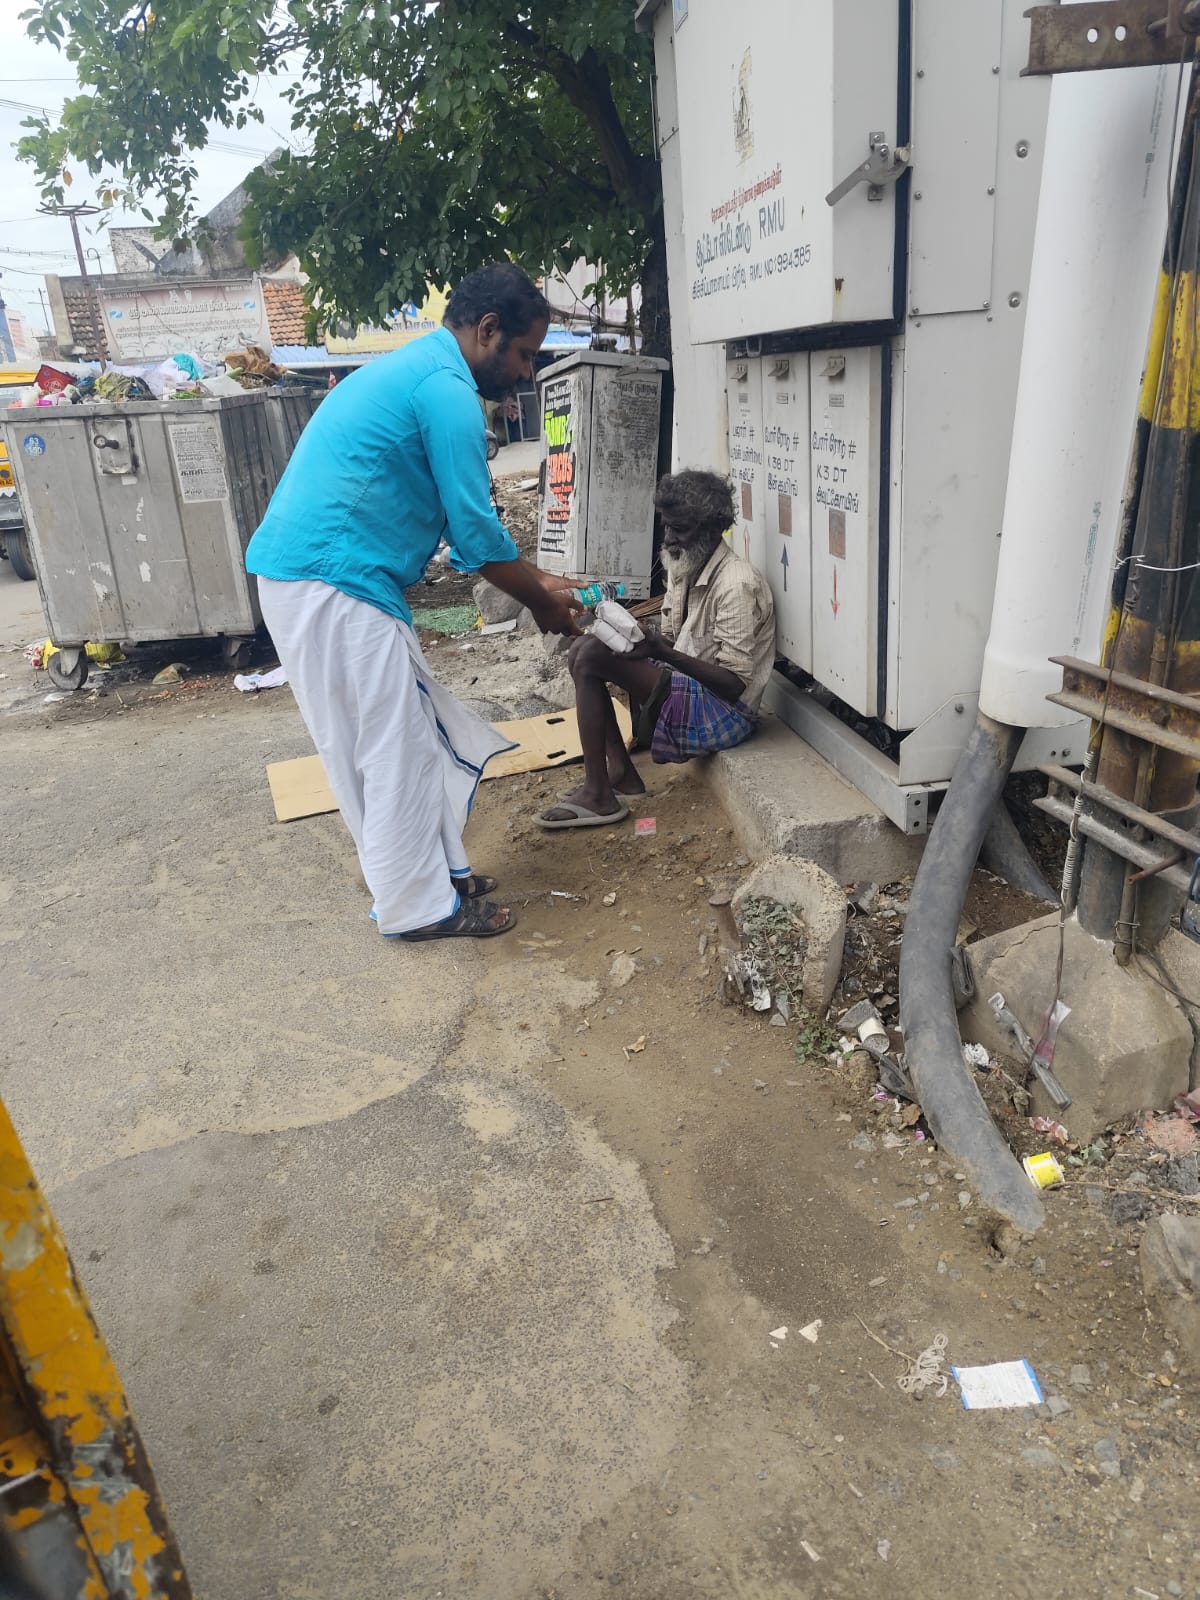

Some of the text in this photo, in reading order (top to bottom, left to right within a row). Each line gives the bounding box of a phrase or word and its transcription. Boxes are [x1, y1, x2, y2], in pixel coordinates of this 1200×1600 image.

[759, 196, 785, 240] RMU
[792, 431, 800, 452] #
[848, 439, 857, 460] #
[783, 458, 796, 473] DT
[832, 466, 848, 484] DT
